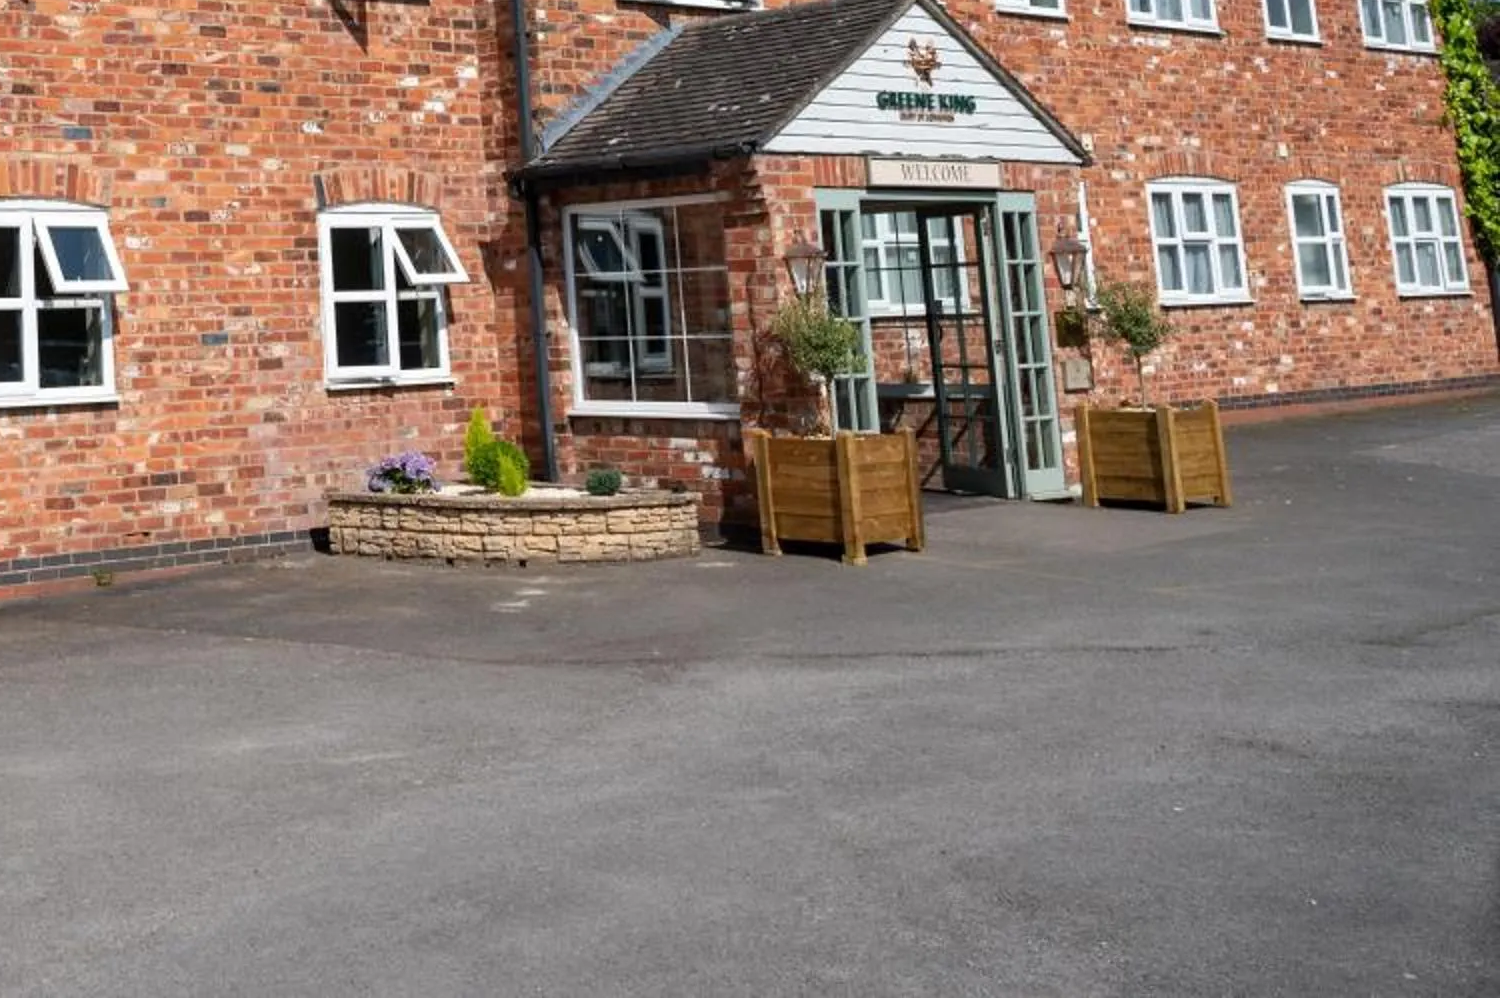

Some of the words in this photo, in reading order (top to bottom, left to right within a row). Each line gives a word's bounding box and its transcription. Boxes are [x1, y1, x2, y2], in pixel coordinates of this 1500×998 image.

[876, 91, 935, 111] GREENE
[938, 93, 977, 115] KING
[900, 163, 973, 182] WELCOME
